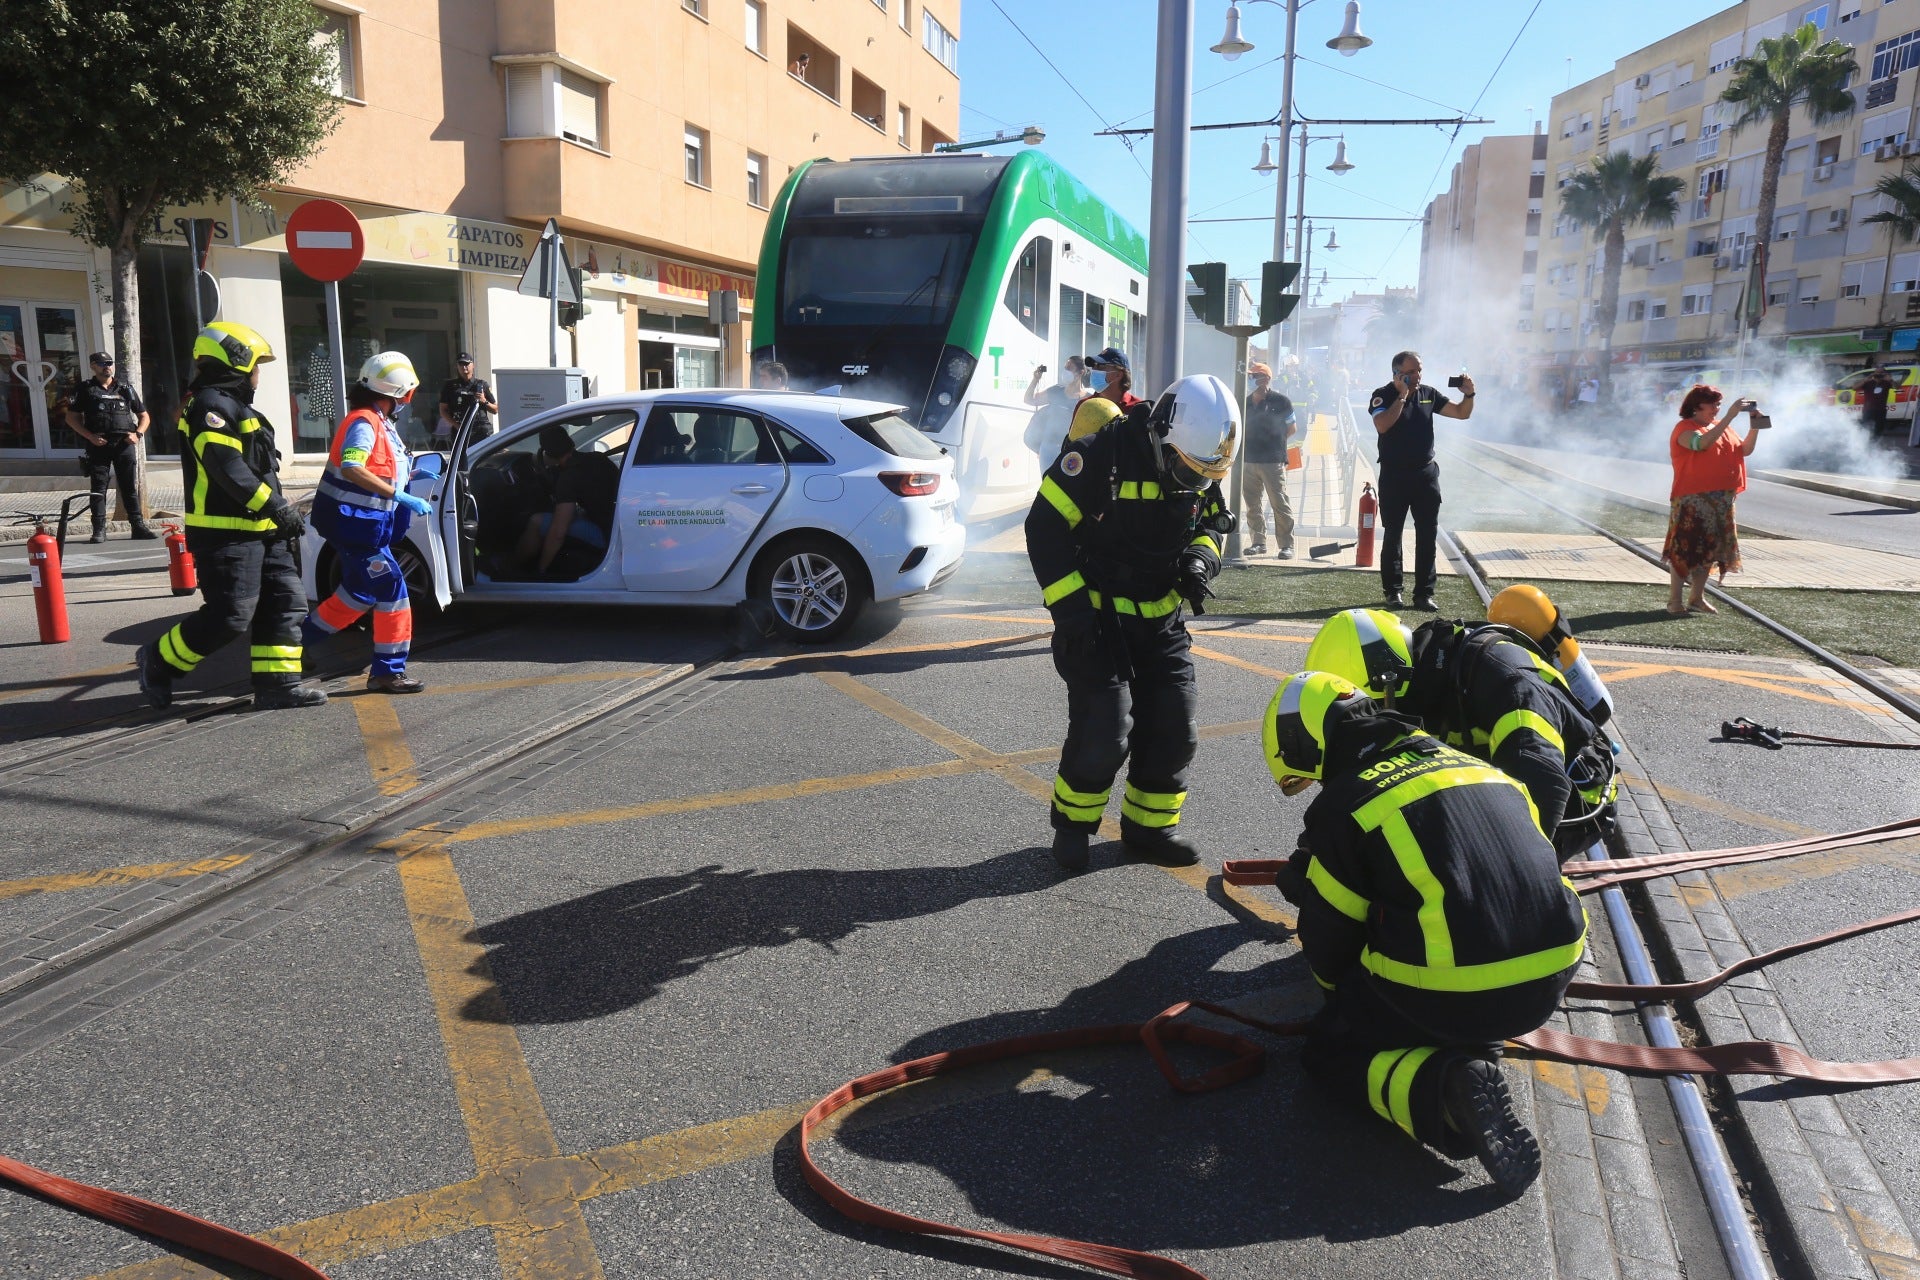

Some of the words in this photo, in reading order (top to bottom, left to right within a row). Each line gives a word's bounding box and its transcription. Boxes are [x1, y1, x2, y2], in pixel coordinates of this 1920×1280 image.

[447, 224, 524, 248] ZAPATOS
[448, 248, 528, 271] LIMPIEZA
[666, 264, 721, 299] SUPER
[842, 365, 869, 375] CAF
[696, 508, 724, 516] PÚBLICA
